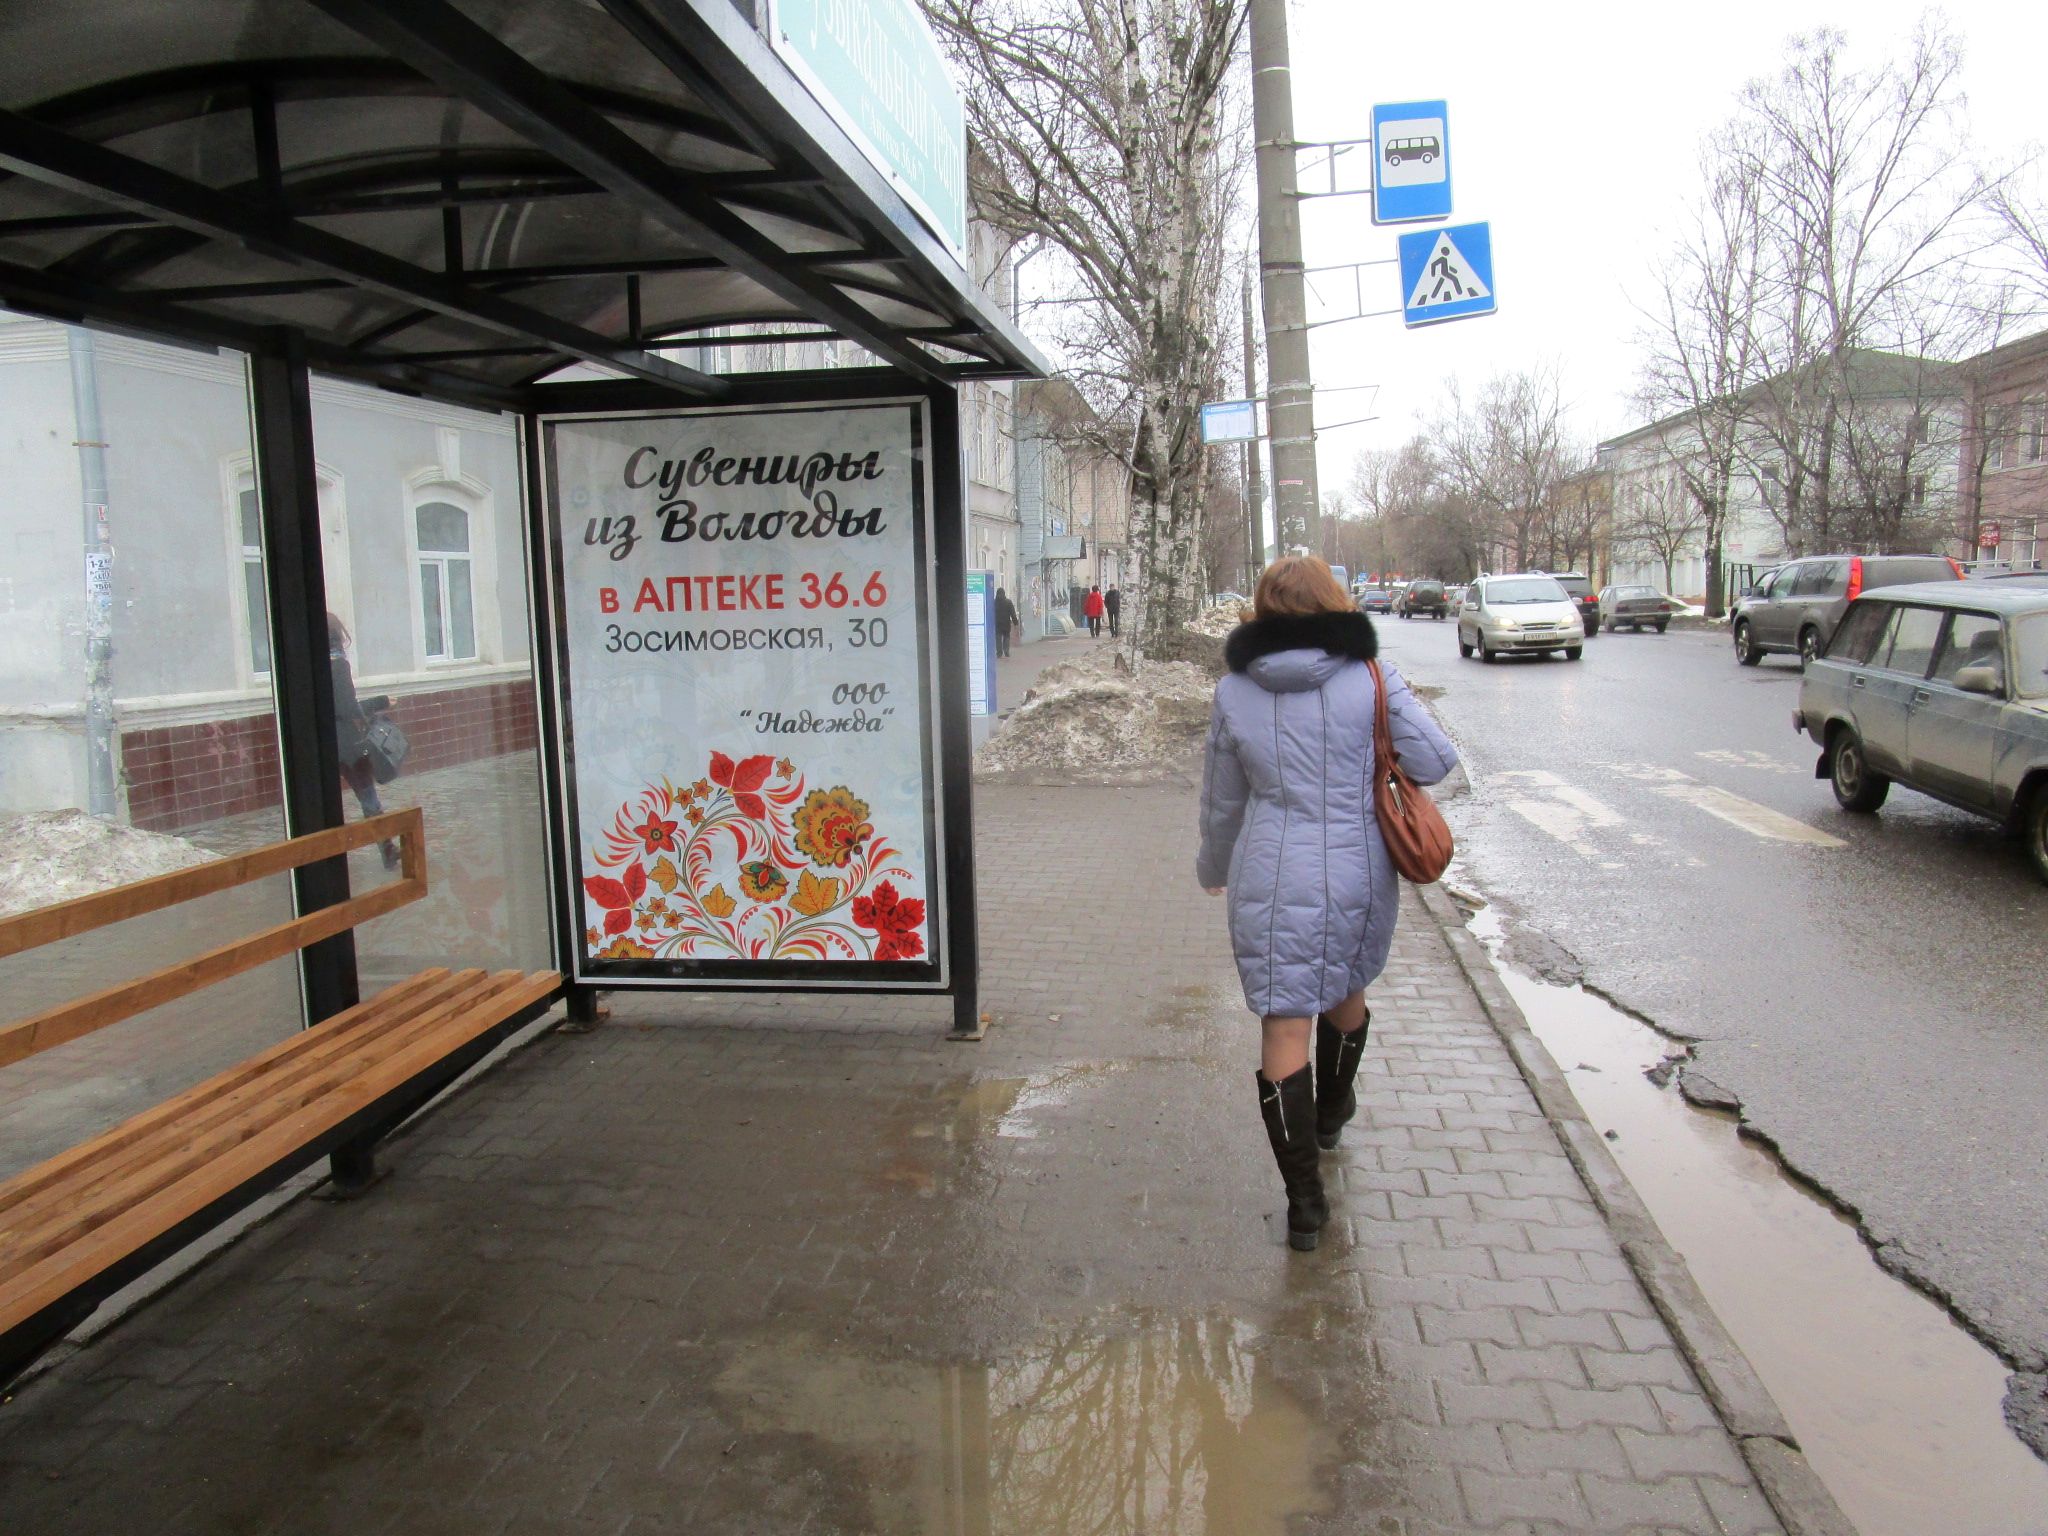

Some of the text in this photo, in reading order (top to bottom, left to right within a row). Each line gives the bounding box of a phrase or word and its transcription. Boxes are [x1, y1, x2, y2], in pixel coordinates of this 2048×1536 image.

[624, 446, 884, 500] Сувениры
[584, 489, 887, 561] из Вологды
[600, 571, 887, 614] в АПТЕКЕ 36.6
[605, 617, 888, 654] Зосимовская, 30
